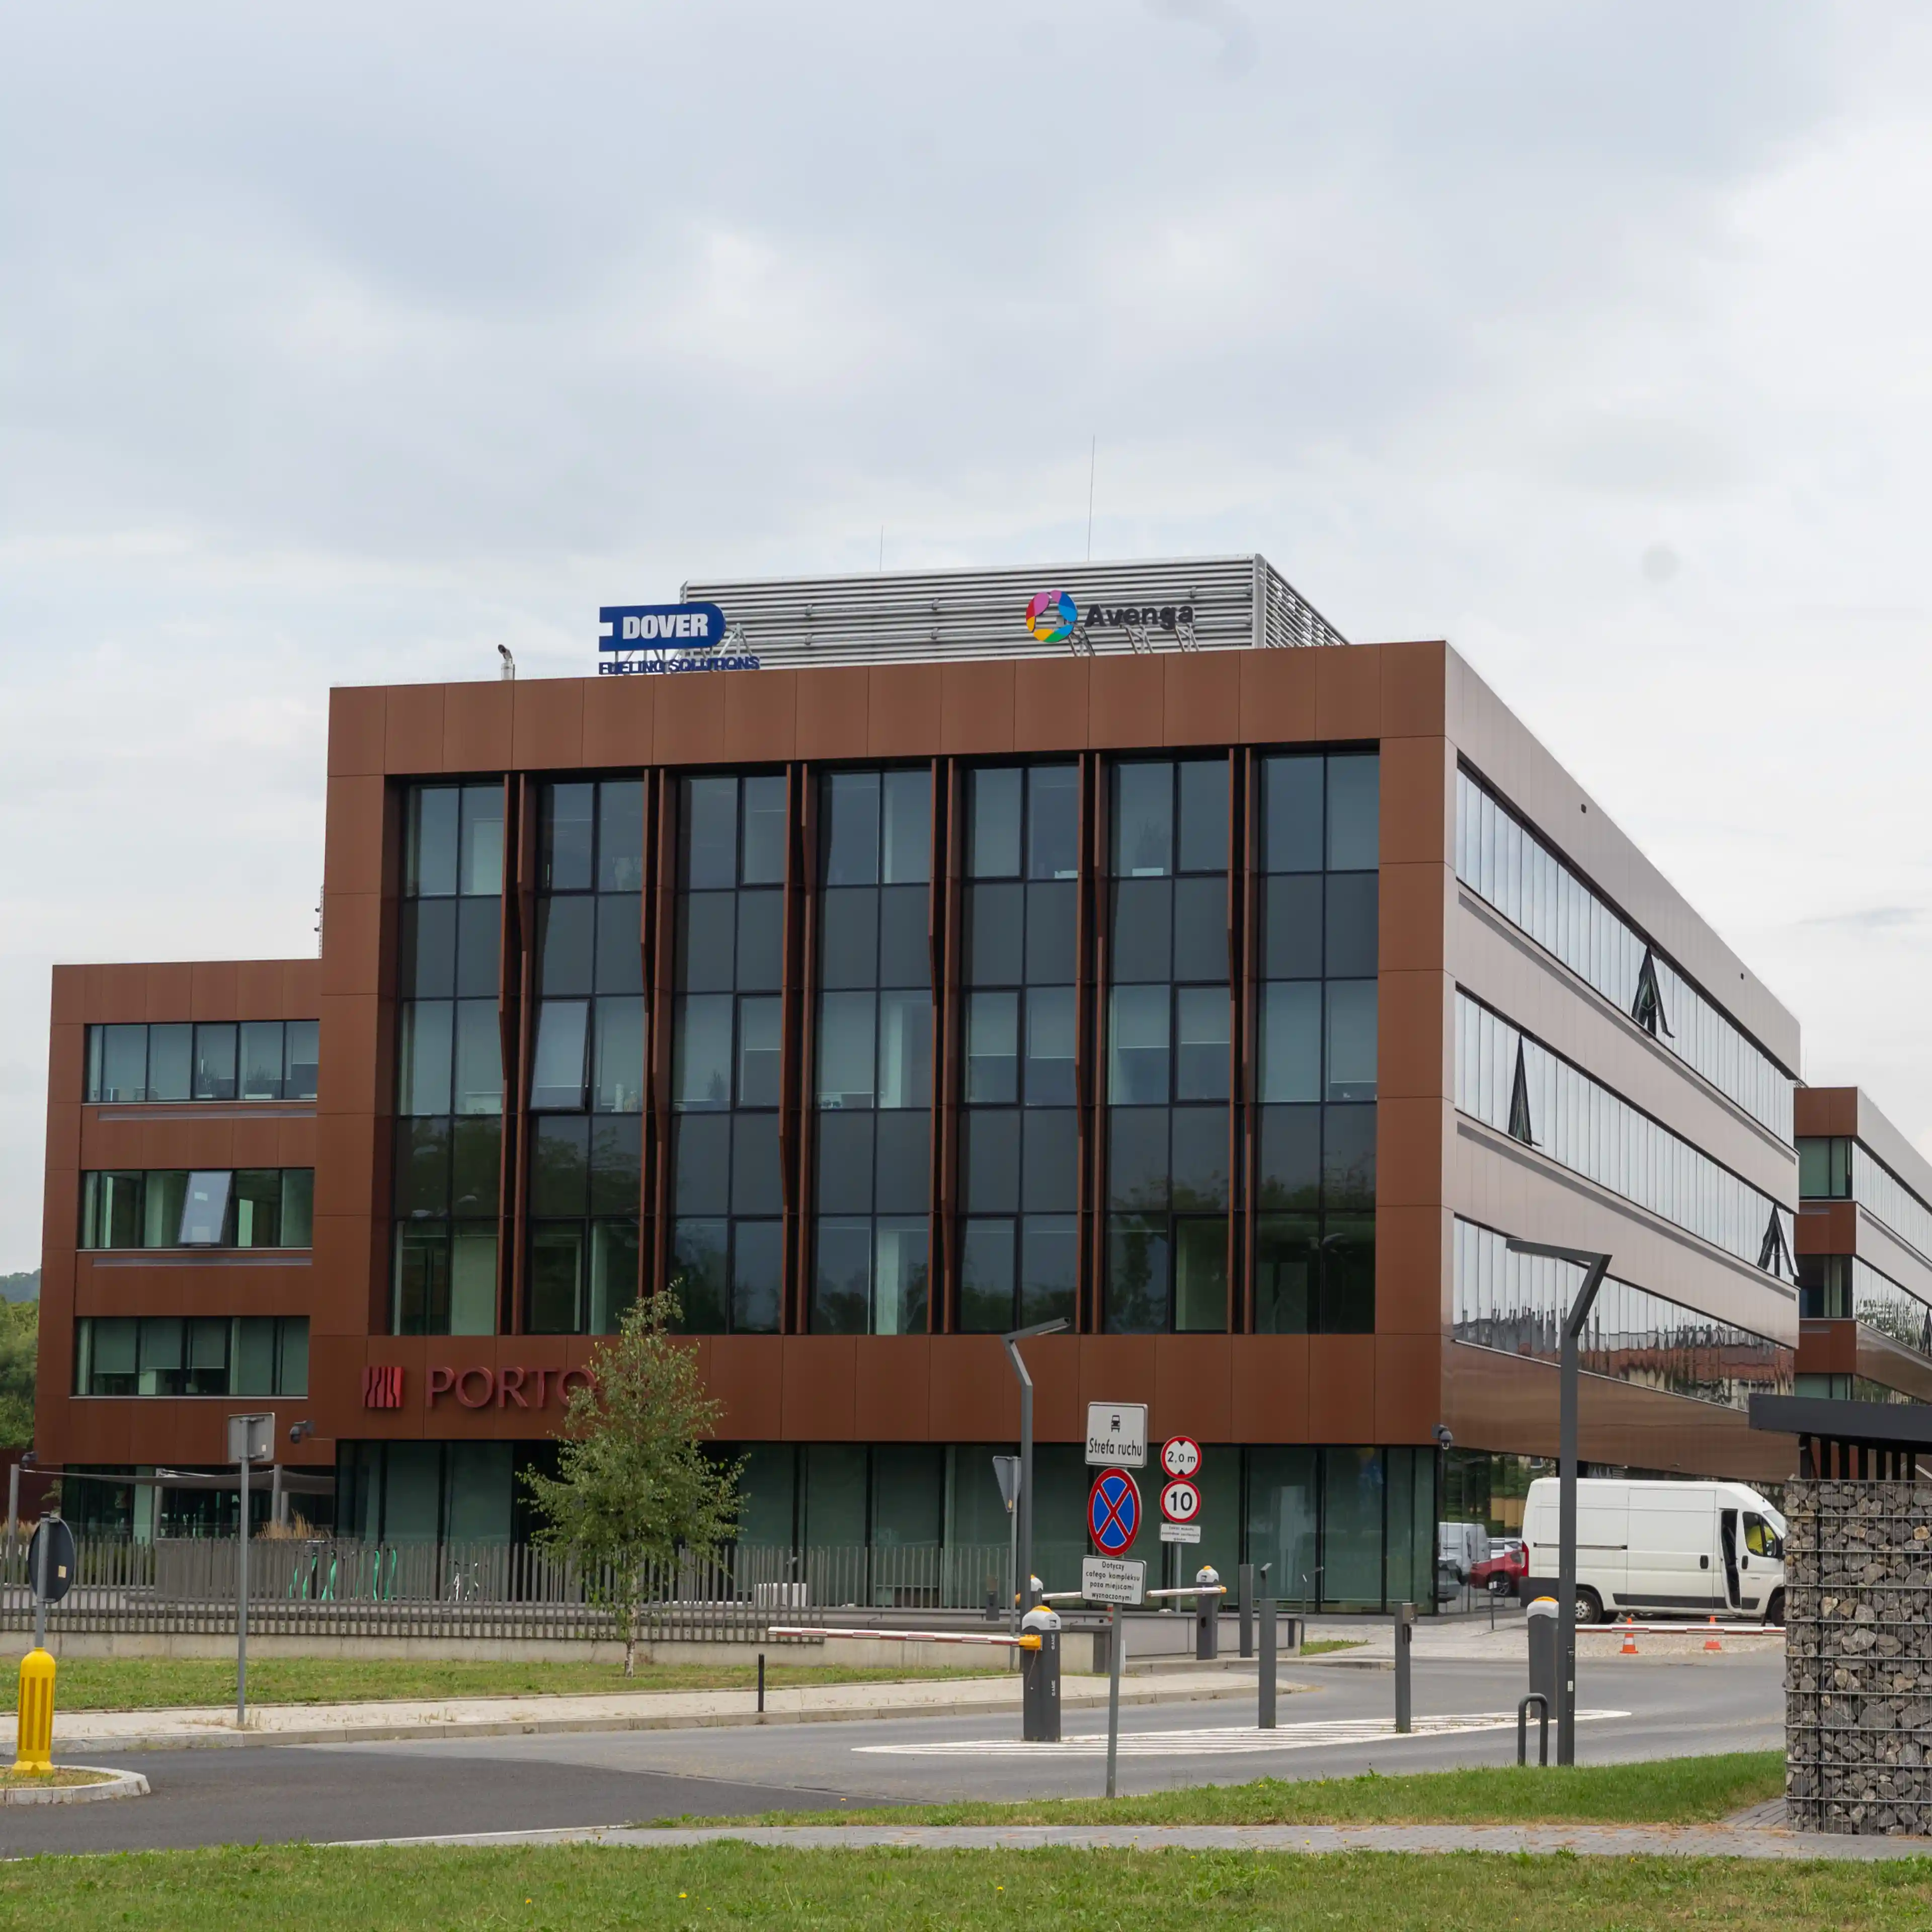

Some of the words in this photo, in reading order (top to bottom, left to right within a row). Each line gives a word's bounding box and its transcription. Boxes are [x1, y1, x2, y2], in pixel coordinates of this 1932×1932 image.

[622, 613, 708, 639] DOVER
[1084, 604, 1194, 630] Avenga
[599, 659, 665, 675] FUELING
[668, 656, 760, 673] SOLUTIONS
[426, 1365, 598, 1408] PORTO
[1089, 1437, 1114, 1455] Strefa
[1118, 1439, 1142, 1457] ruchu
[1170, 1491, 1193, 1511] 10
[1086, 1570, 1106, 1579] całego
[1108, 1572, 1140, 1581] kompleksu
[1102, 1561, 1124, 1571] Dotyczy
[1105, 1582, 1134, 1591] miejscami
[1092, 1592, 1132, 1602] wyznaczonymi
